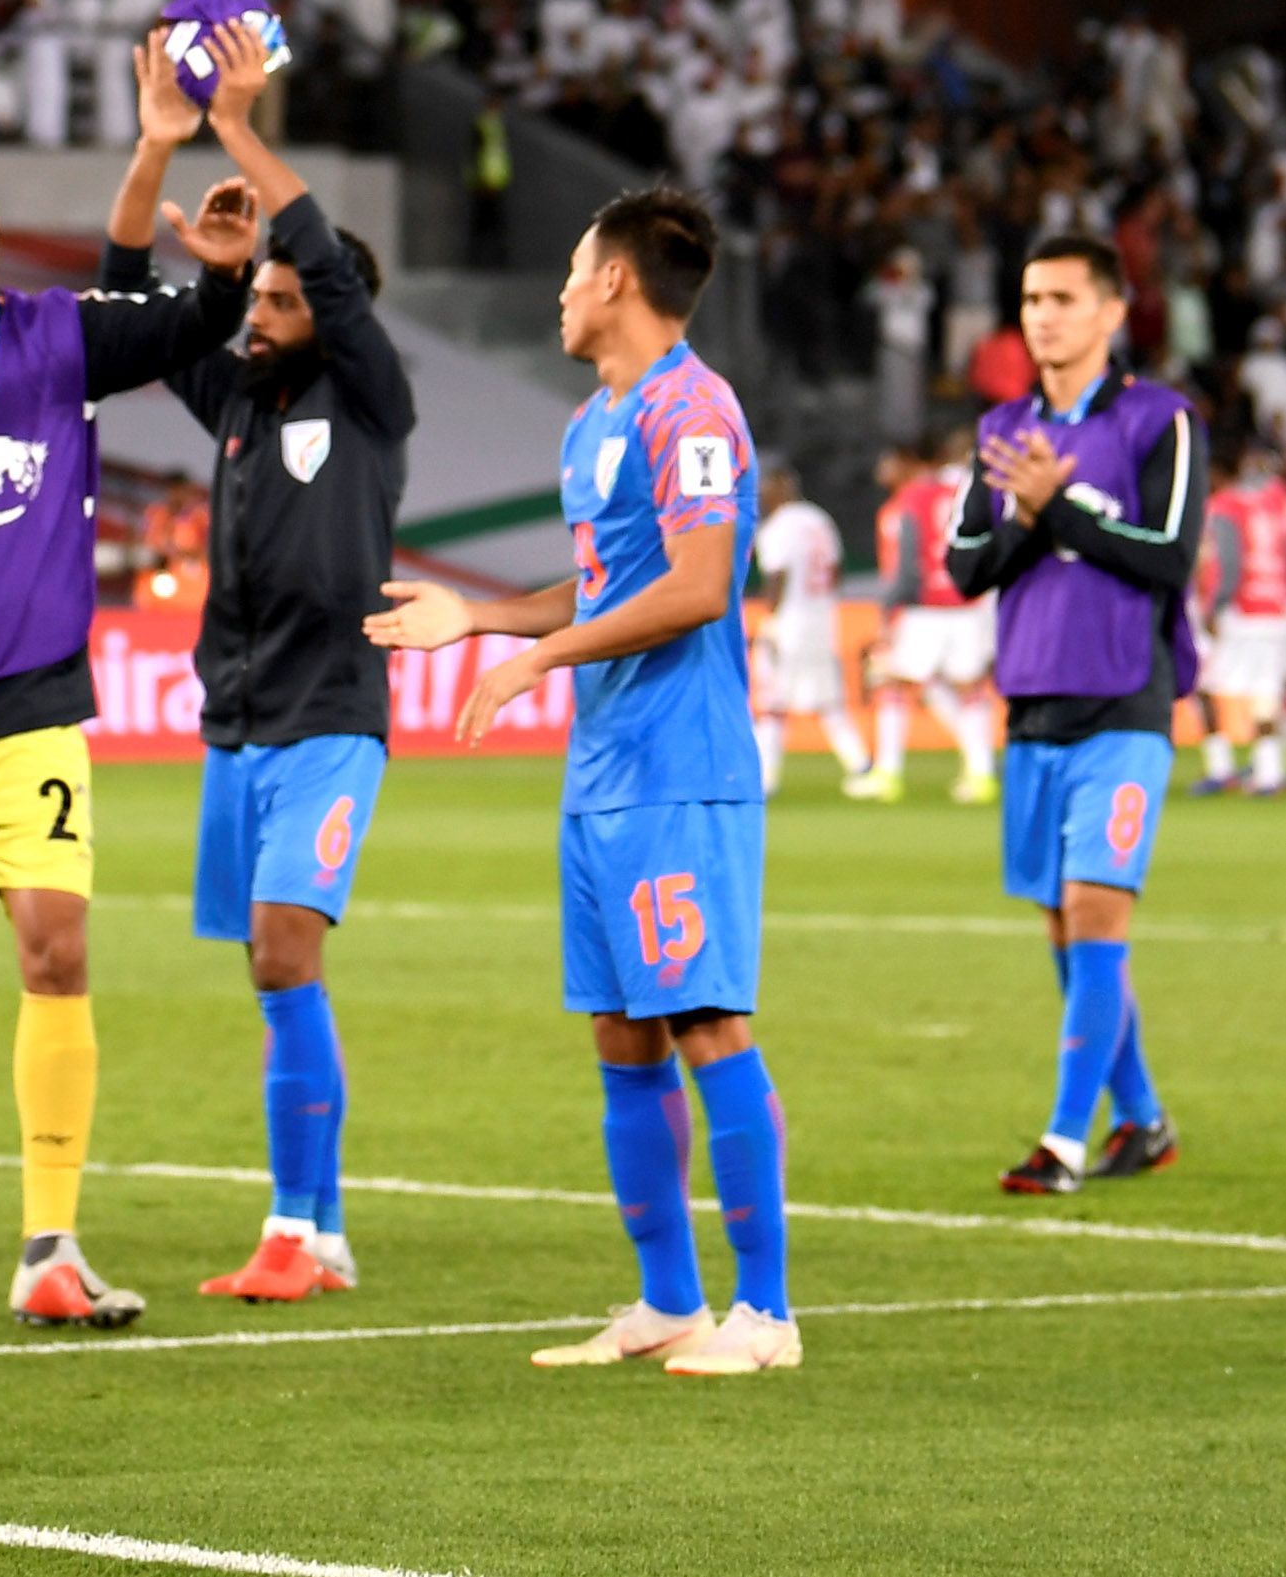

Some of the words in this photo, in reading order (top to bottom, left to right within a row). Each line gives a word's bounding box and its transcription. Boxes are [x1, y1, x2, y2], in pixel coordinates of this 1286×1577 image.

[315, 795, 355, 870] 6
[1105, 780, 1148, 853] 8
[630, 871, 705, 965] 15
